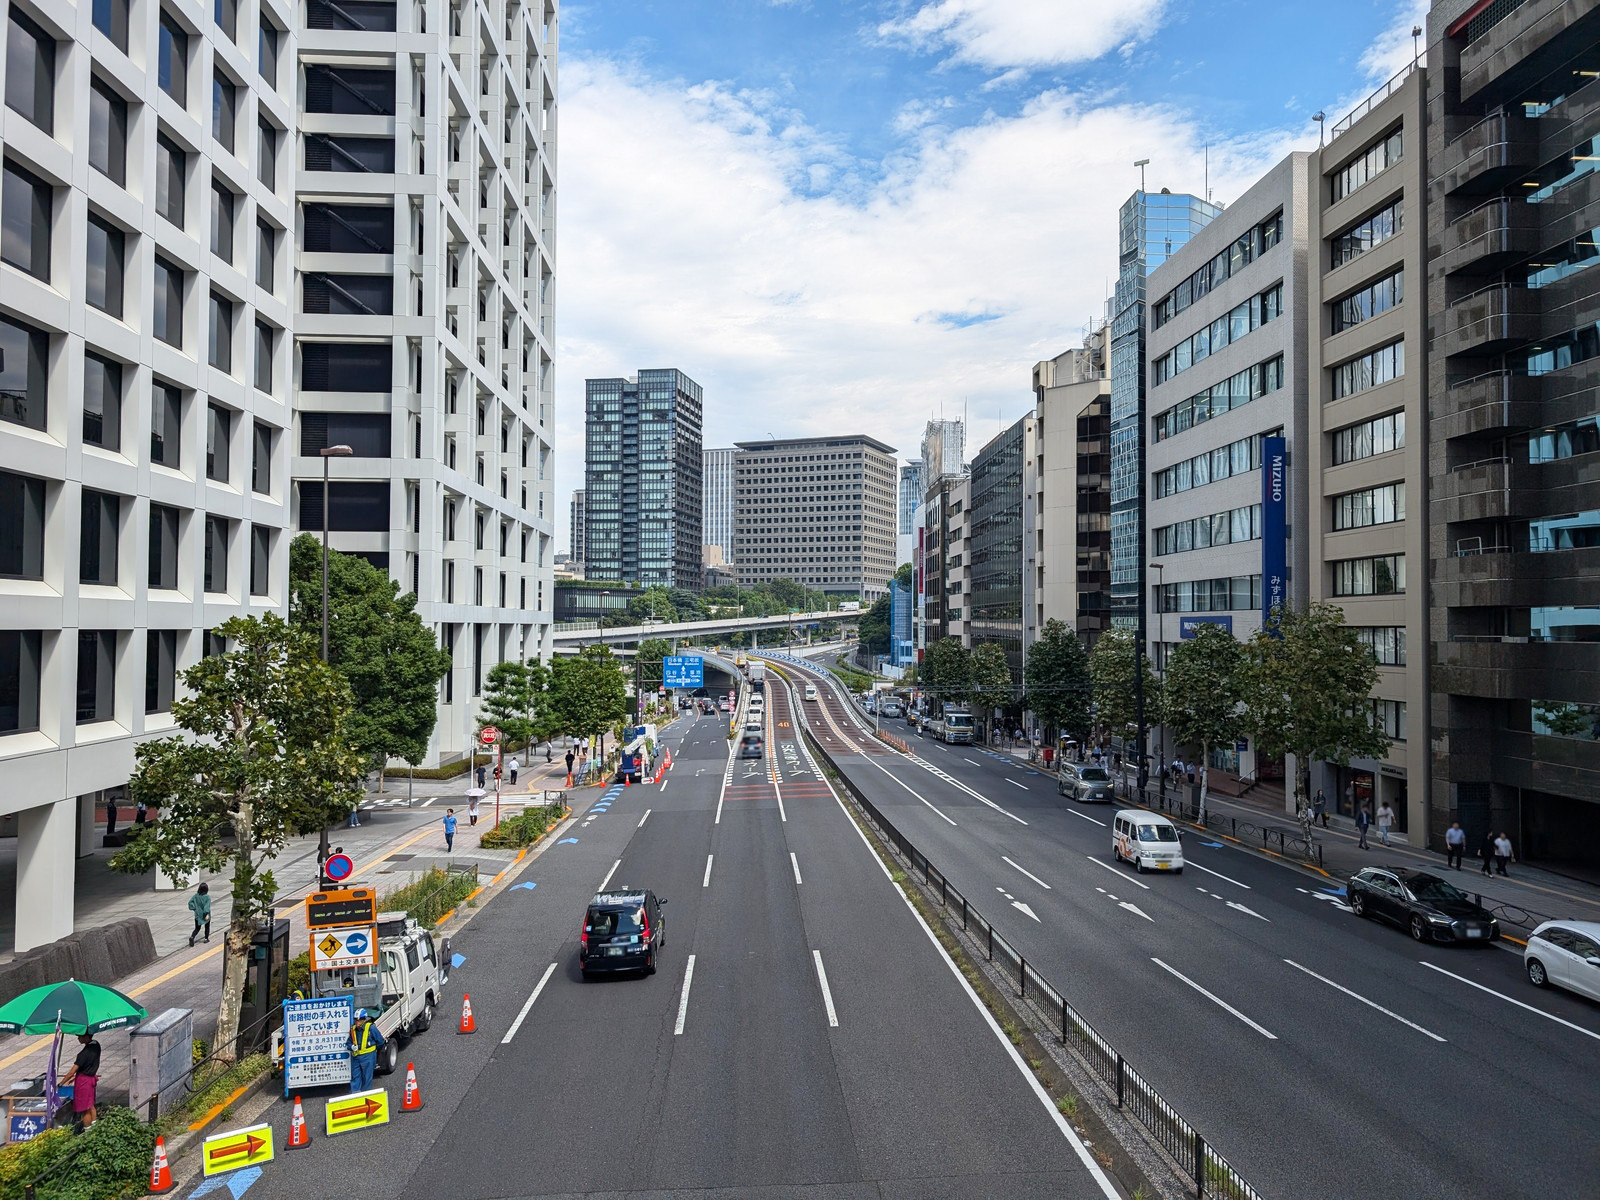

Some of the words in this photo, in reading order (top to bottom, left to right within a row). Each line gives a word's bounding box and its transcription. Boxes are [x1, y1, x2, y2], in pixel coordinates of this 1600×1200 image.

[1272, 455, 1282, 502] MIZUHO
[331, 958, 366, 967] 国土交通省
[288, 1001, 347, 1010] ご迷惑をおかけします
[289, 1010, 349, 1022] 街路樹の手入れを
[298, 1021, 340, 1032] 行っています
